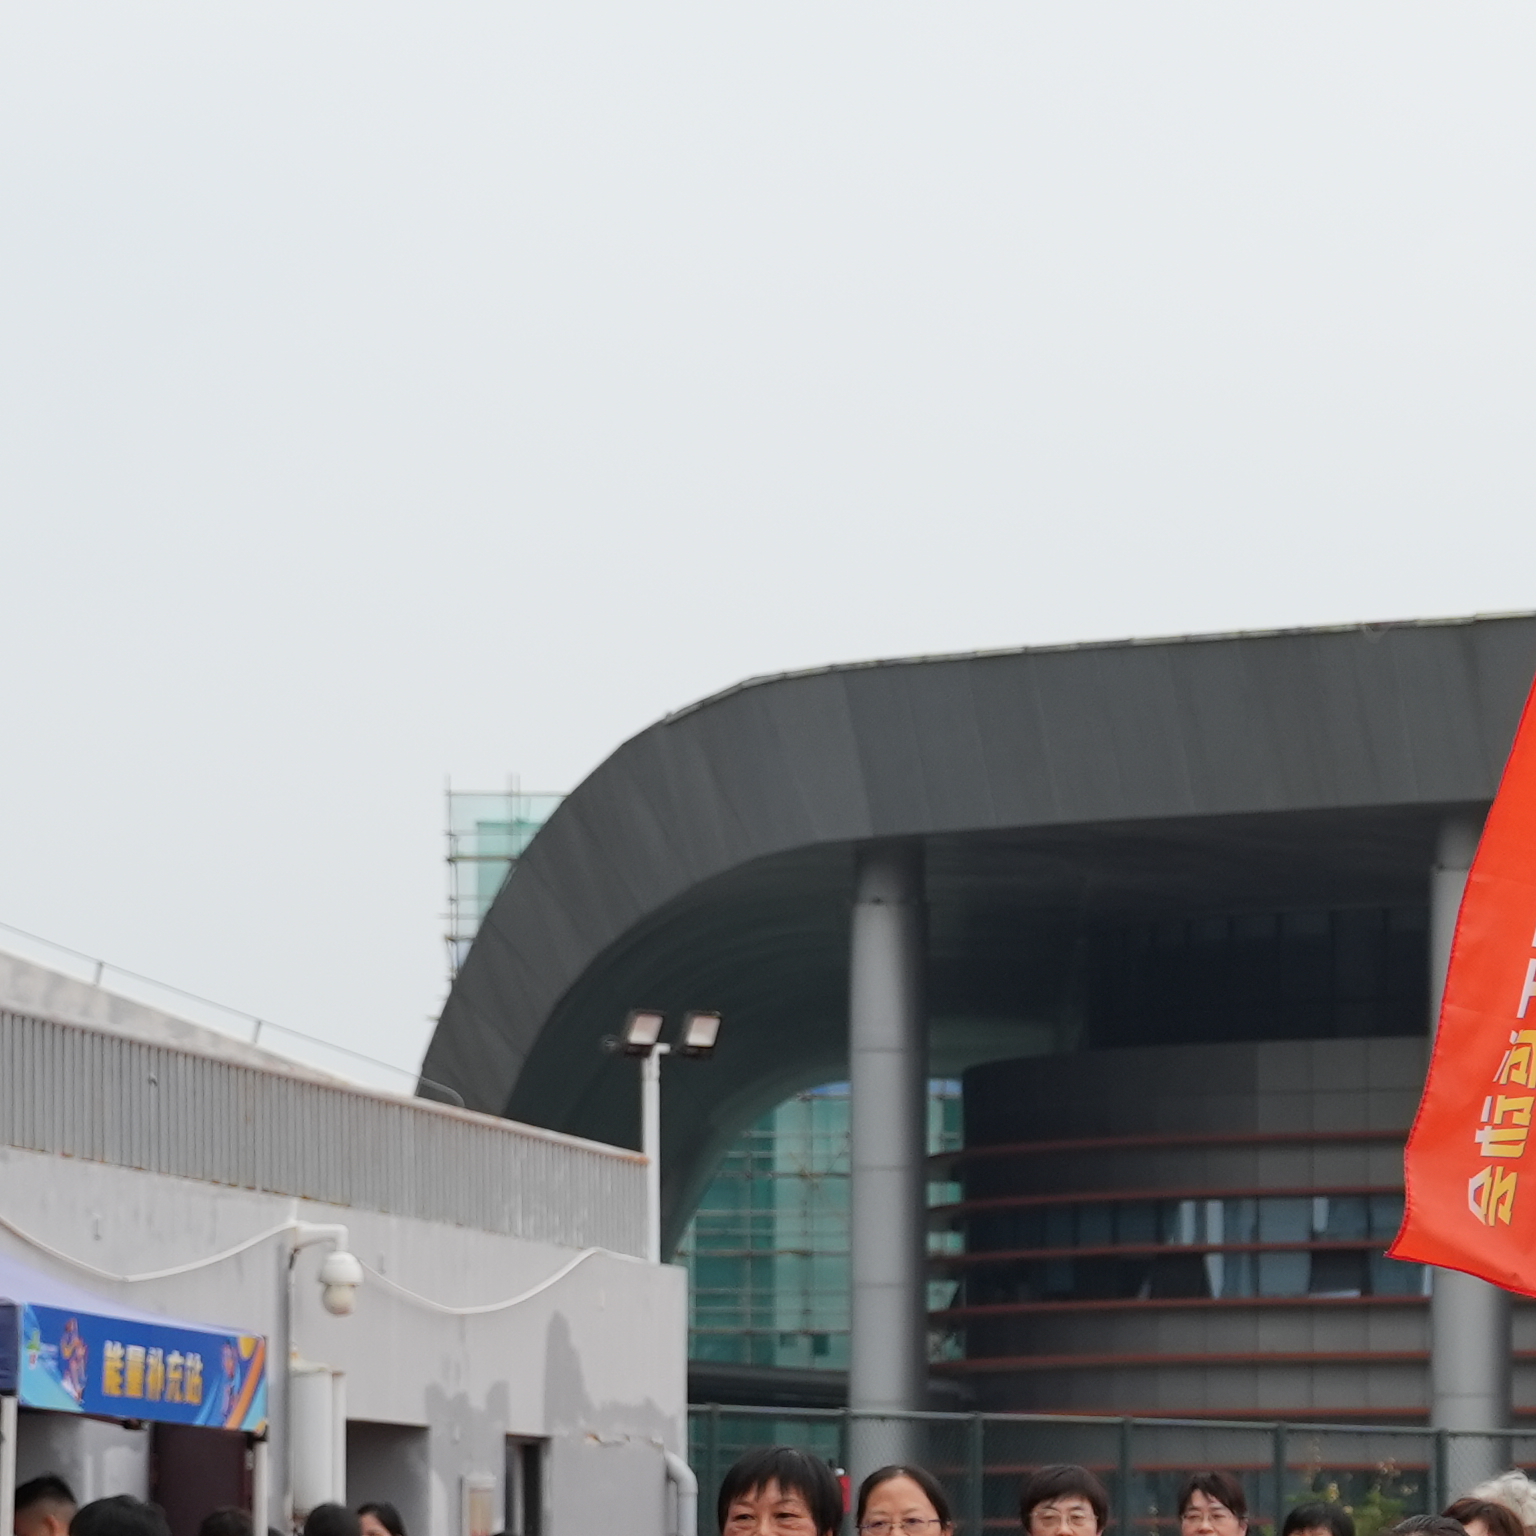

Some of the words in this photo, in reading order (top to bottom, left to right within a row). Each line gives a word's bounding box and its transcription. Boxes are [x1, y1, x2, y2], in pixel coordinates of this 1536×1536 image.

[102, 1339, 204, 1406] 能量补充站
